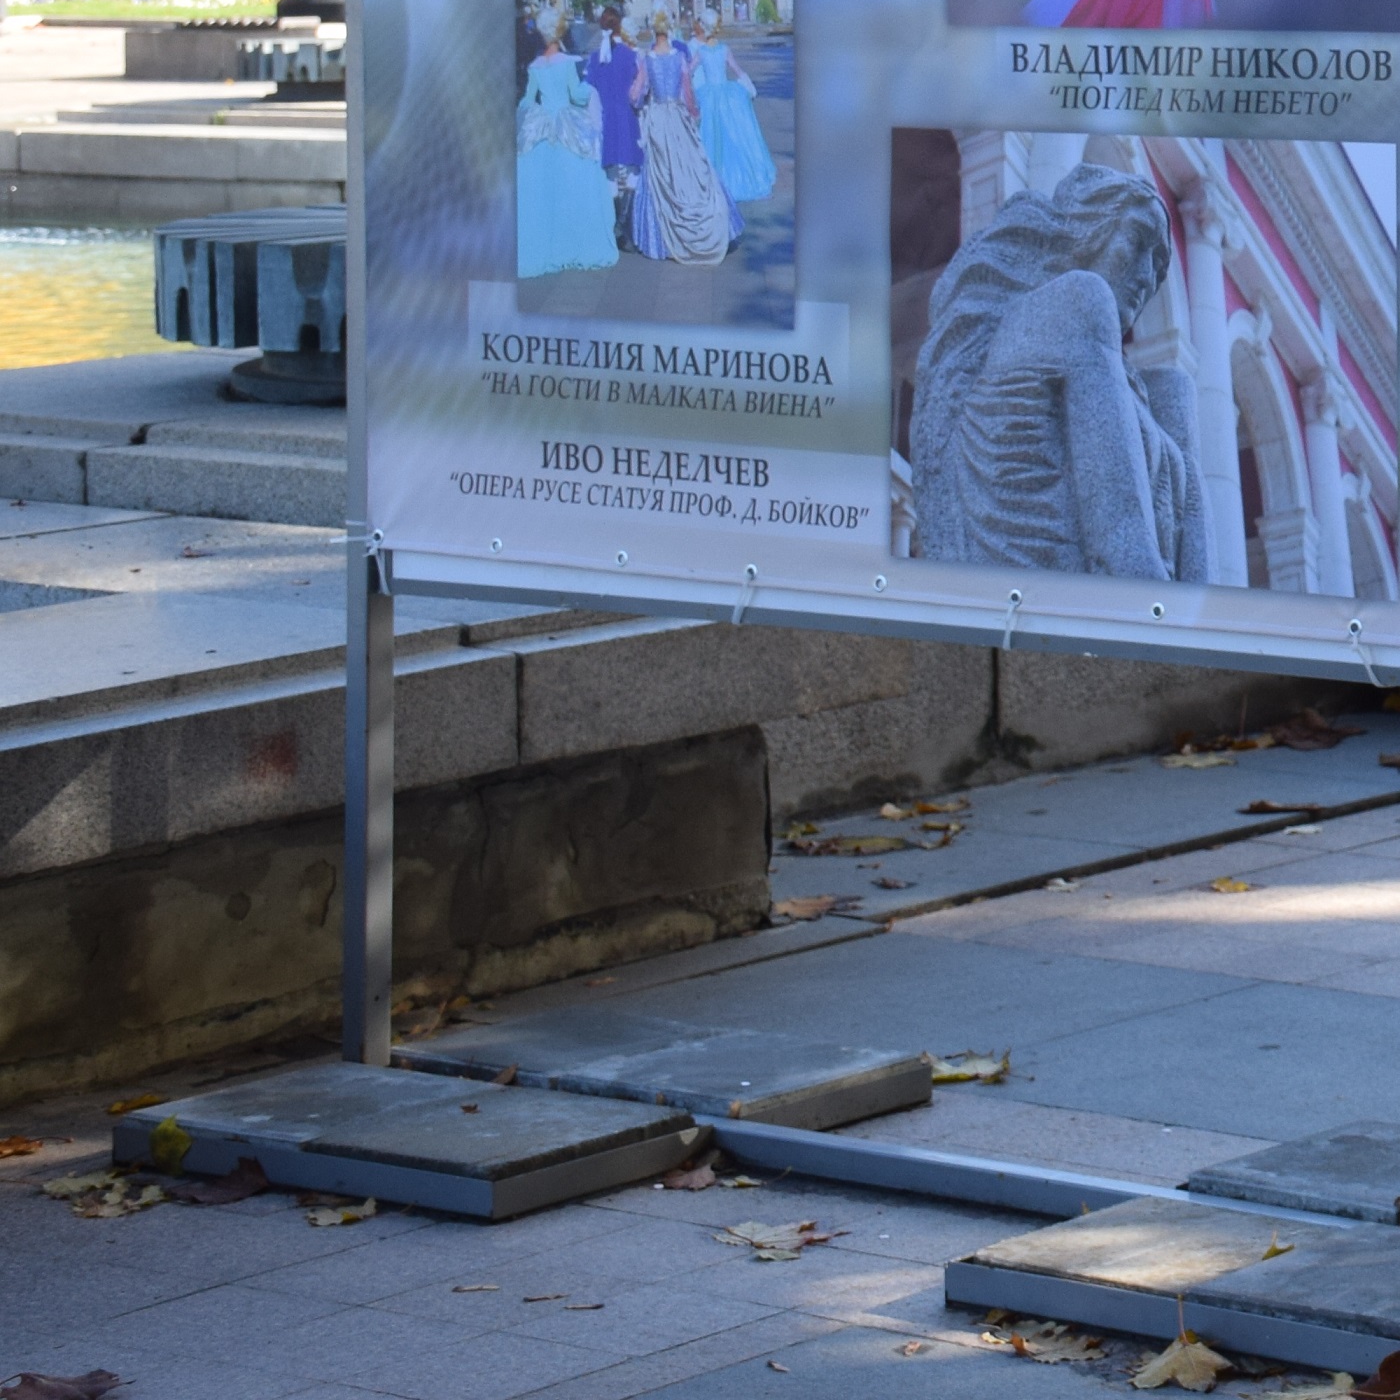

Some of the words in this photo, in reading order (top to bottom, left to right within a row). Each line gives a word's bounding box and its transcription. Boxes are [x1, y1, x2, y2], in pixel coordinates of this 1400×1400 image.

[1011, 42, 1203, 82] ВЛАДИМИР
[1211, 47, 1393, 82] НИКОЛОВ
[1049, 85, 1162, 116] “ПОГЛЕД
[1169, 88, 1225, 115] КЪМ
[1232, 90, 1351, 117] НЕБЕТО”
[481, 332, 645, 373] КОРНЕЛИЯ
[653, 344, 834, 386] МАРИНОВА
[481, 371, 522, 396] “НА
[528, 374, 601, 401] ГОСТИ
[607, 380, 621, 401] В
[626, 381, 737, 413] МАЛКАТА
[743, 390, 836, 420] ВИЕНА”
[541, 440, 604, 474] ИВО
[613, 446, 770, 488] НЕДЕЛЧЕВ
[450, 470, 526, 500] “ОПЕРА
[532, 476, 582, 505] РУСЕ
[586, 483, 664, 513] СТАТУЯ
[669, 490, 737, 521] ПРОФ.
[741, 498, 762, 526] Д.
[768, 495, 869, 530] БОЙКОВ”
